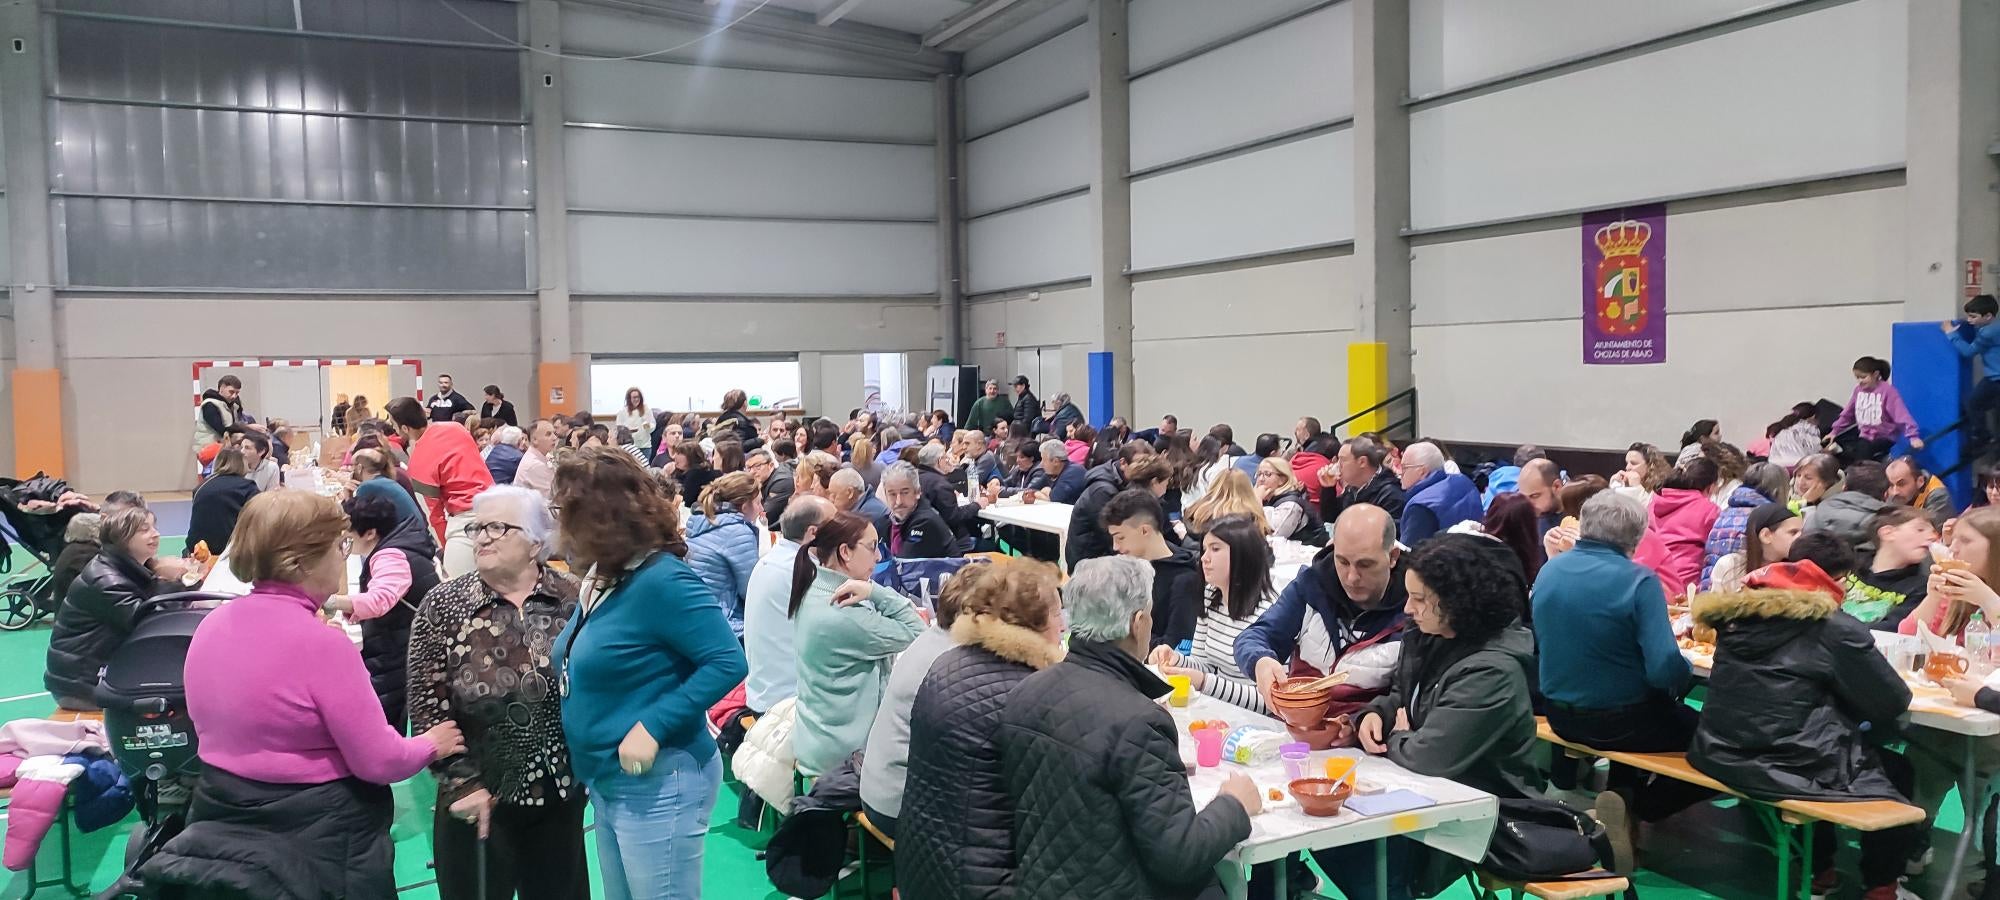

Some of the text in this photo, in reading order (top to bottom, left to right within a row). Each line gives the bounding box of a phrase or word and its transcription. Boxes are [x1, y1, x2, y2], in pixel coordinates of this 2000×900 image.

[1594, 339, 1653, 349] AYUNTAMIENTO DE
[1594, 349, 1653, 358] CHOZAS DE ABAJO
